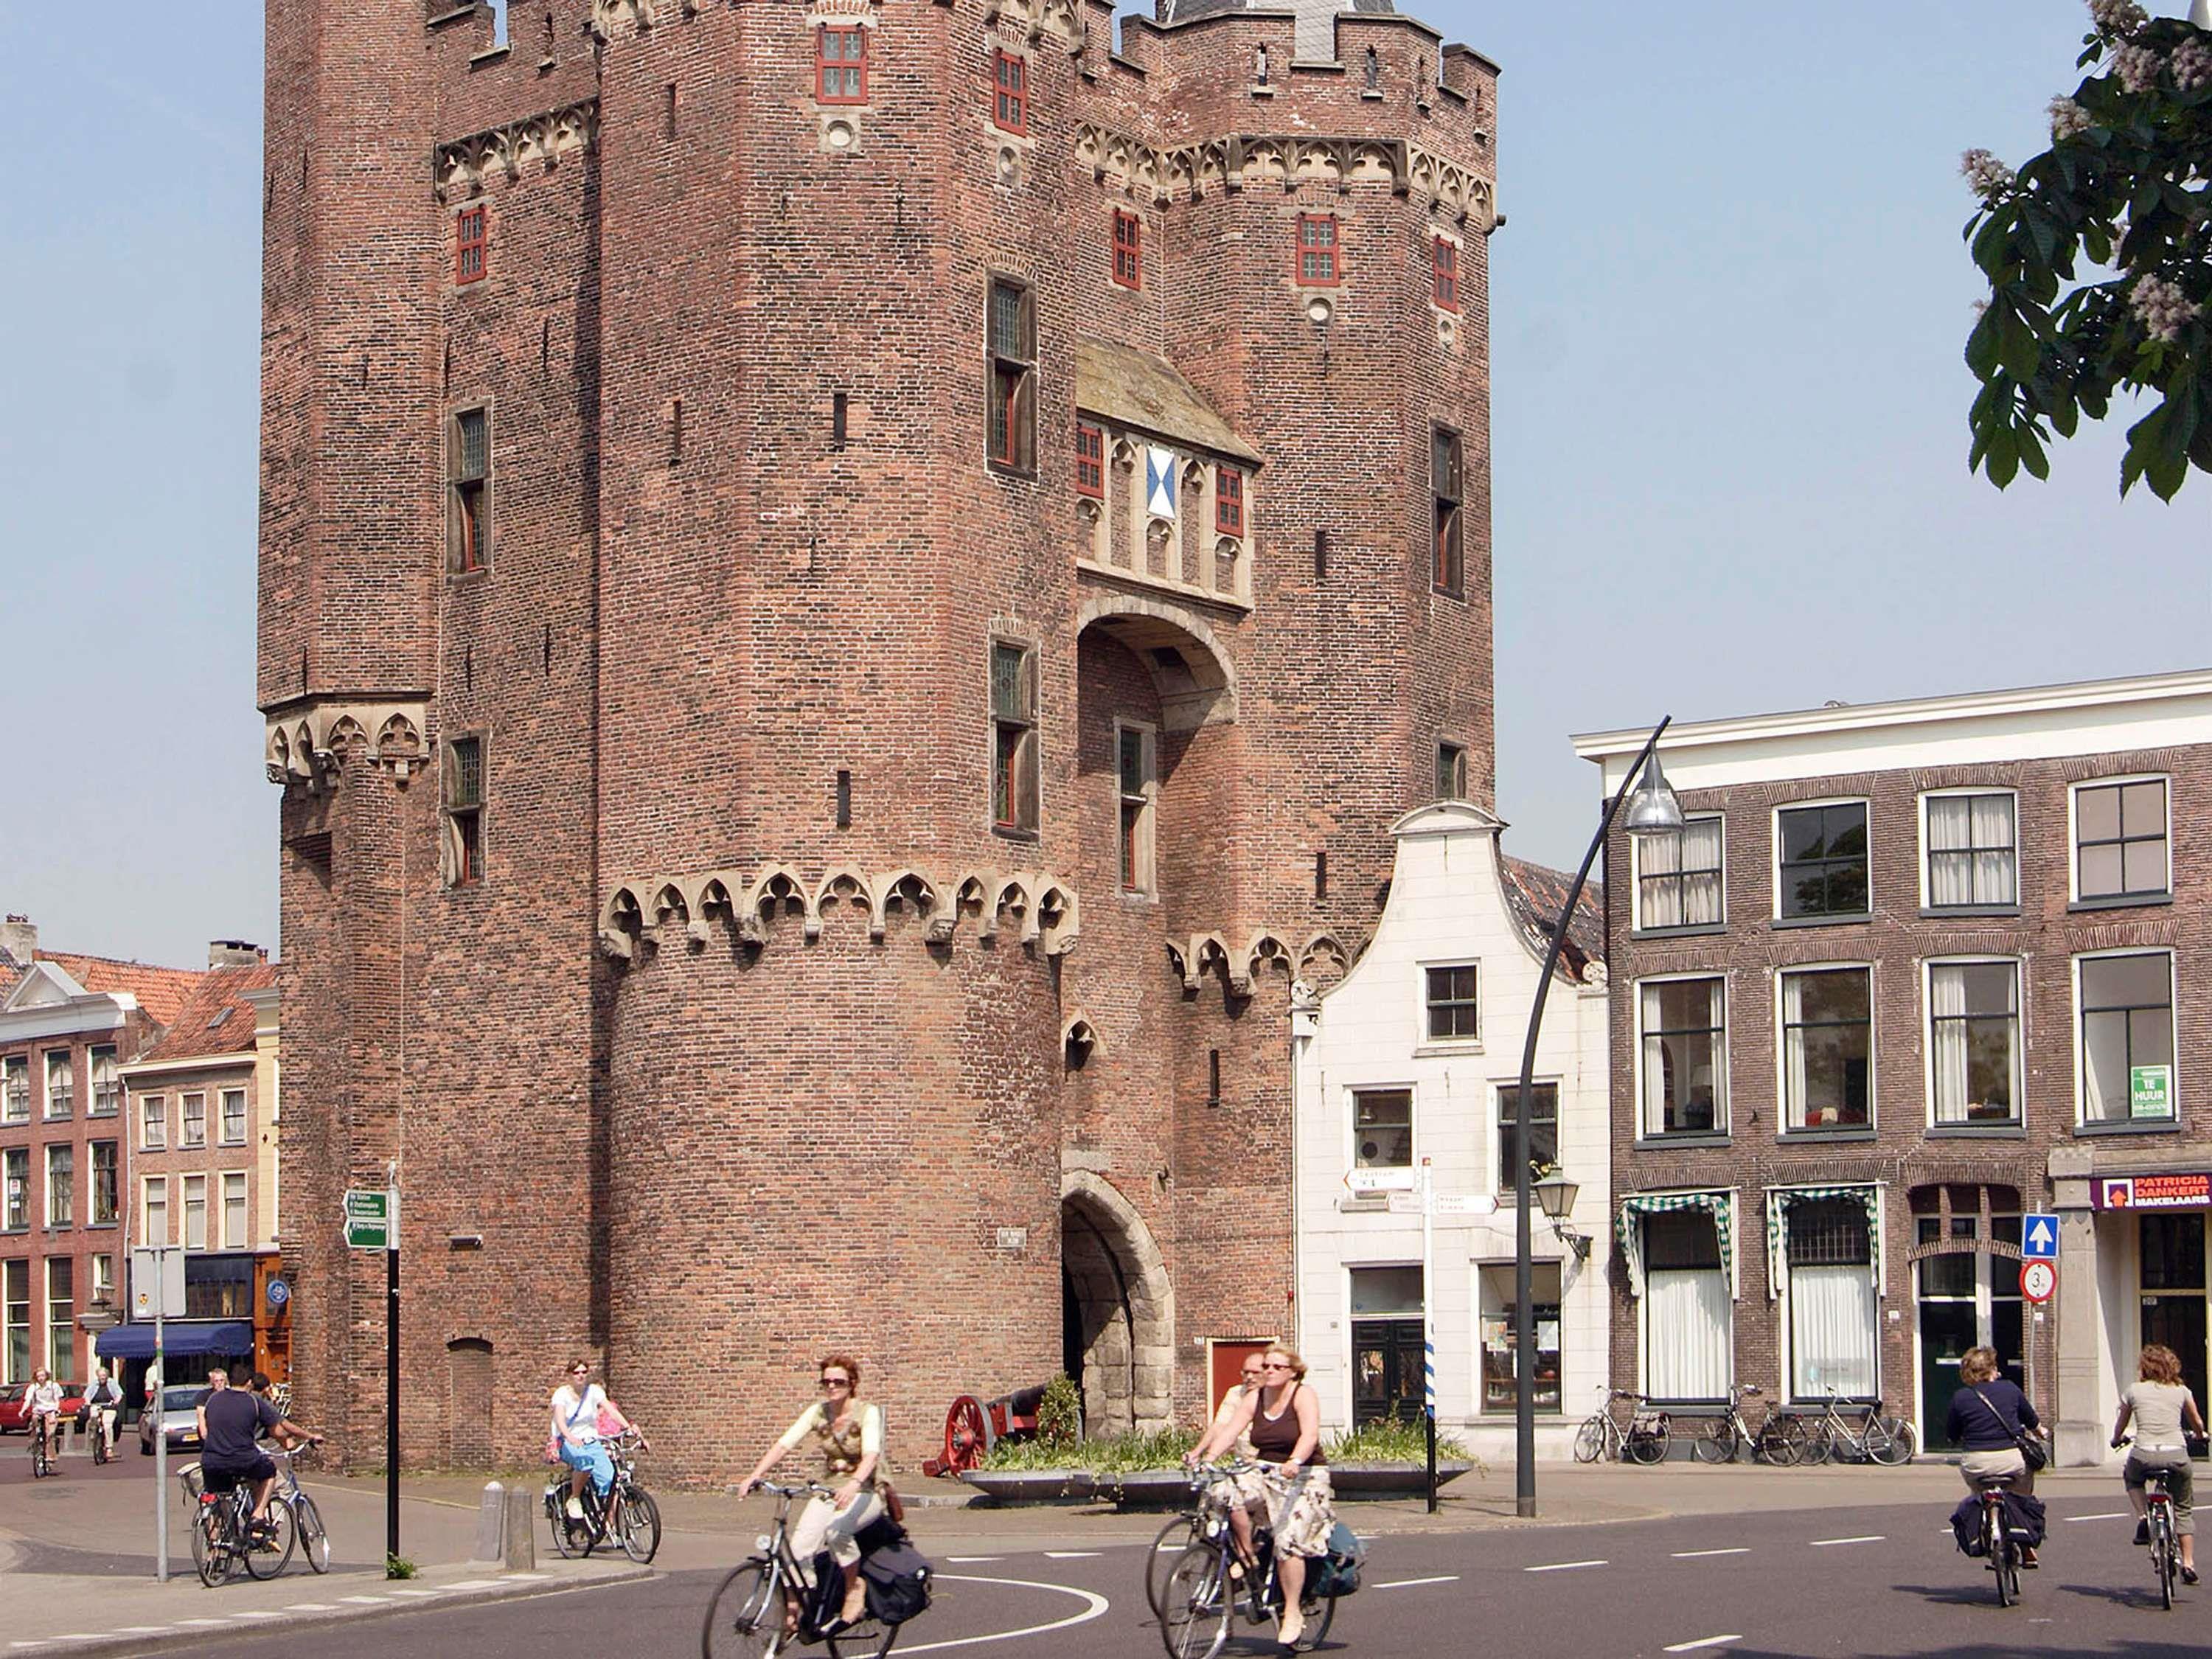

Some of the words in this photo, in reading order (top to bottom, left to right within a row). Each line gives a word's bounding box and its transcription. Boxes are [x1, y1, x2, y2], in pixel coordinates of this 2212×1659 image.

[2143, 1079, 2155, 1090] TE
[2135, 1091, 2165, 1101] HUUR
[2134, 1175, 2208, 1187] PATRICIA
[2134, 1185, 2210, 1197] DANKERT
[2135, 1194, 2211, 1206] MAKELAARS
